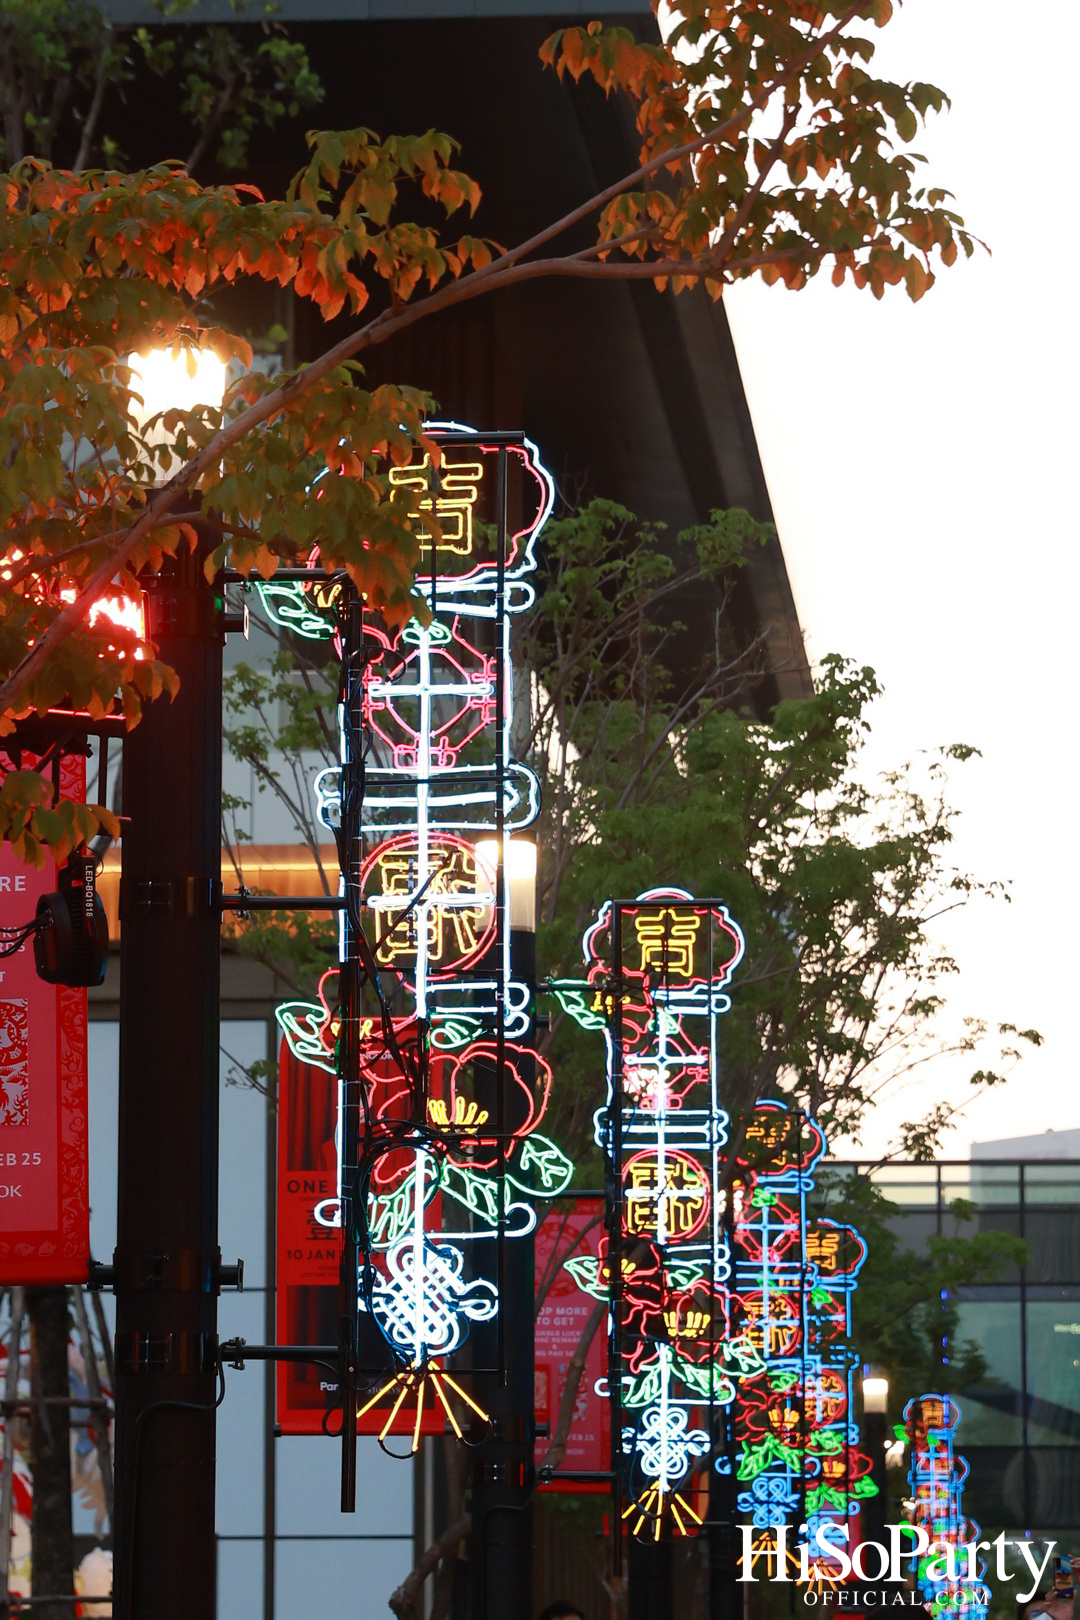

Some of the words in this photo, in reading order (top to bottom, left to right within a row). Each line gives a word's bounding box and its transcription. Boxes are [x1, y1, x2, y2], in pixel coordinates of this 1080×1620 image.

[21, 1152, 41, 1166] 25
[287, 1179, 328, 1194] ONE
[307, 1249, 336, 1260] JAN
[556, 1306, 588, 1316] MORE
[553, 1316, 575, 1326] GET
